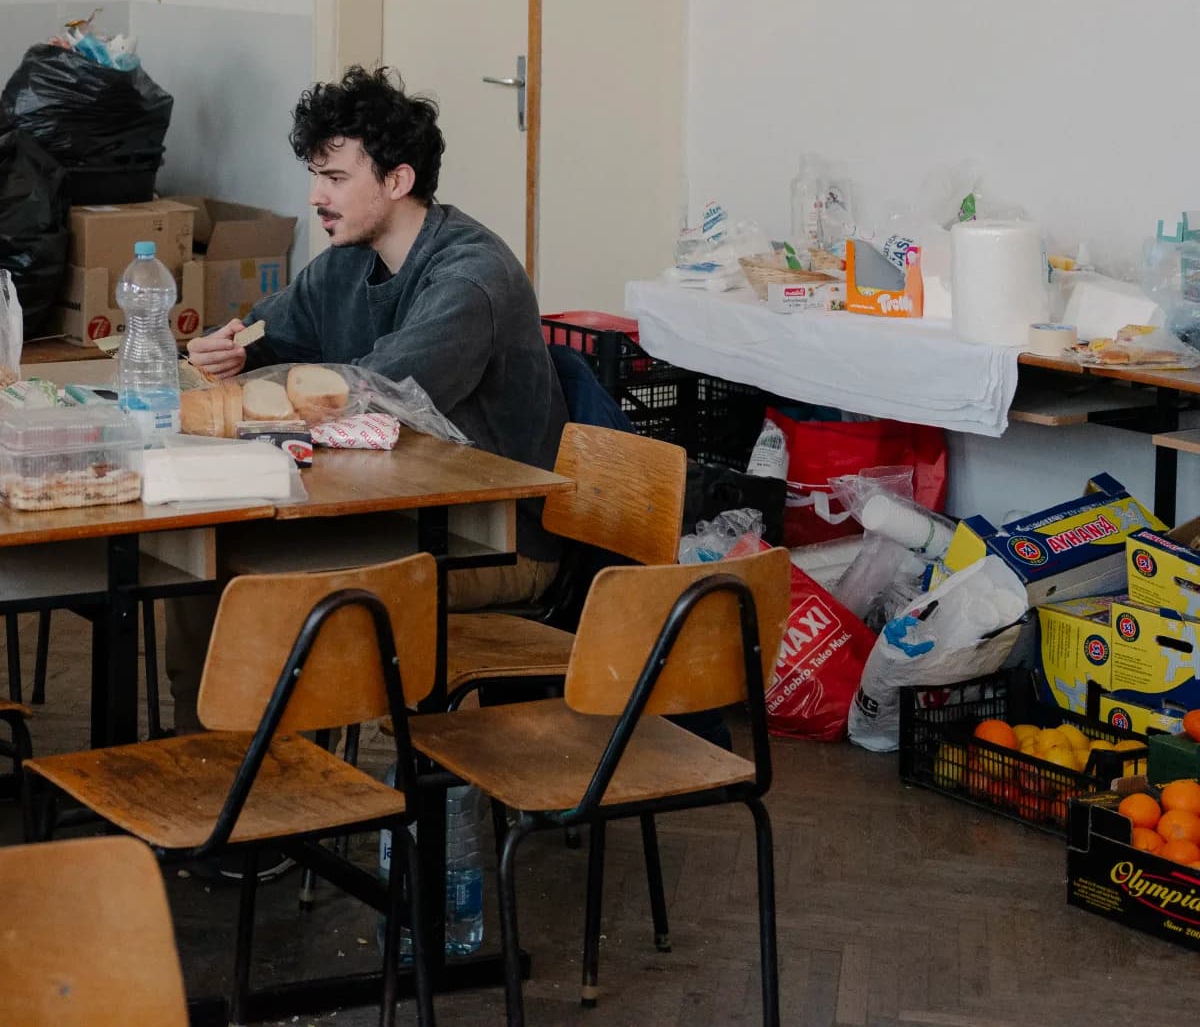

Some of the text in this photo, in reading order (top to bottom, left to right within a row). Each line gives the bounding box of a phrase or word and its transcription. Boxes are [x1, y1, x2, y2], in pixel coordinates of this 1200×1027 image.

[783, 667, 814, 696] dobro.
[809, 648, 833, 668] Tako
[829, 631, 852, 652] Maxi.
[1163, 919, 1183, 933] Since
